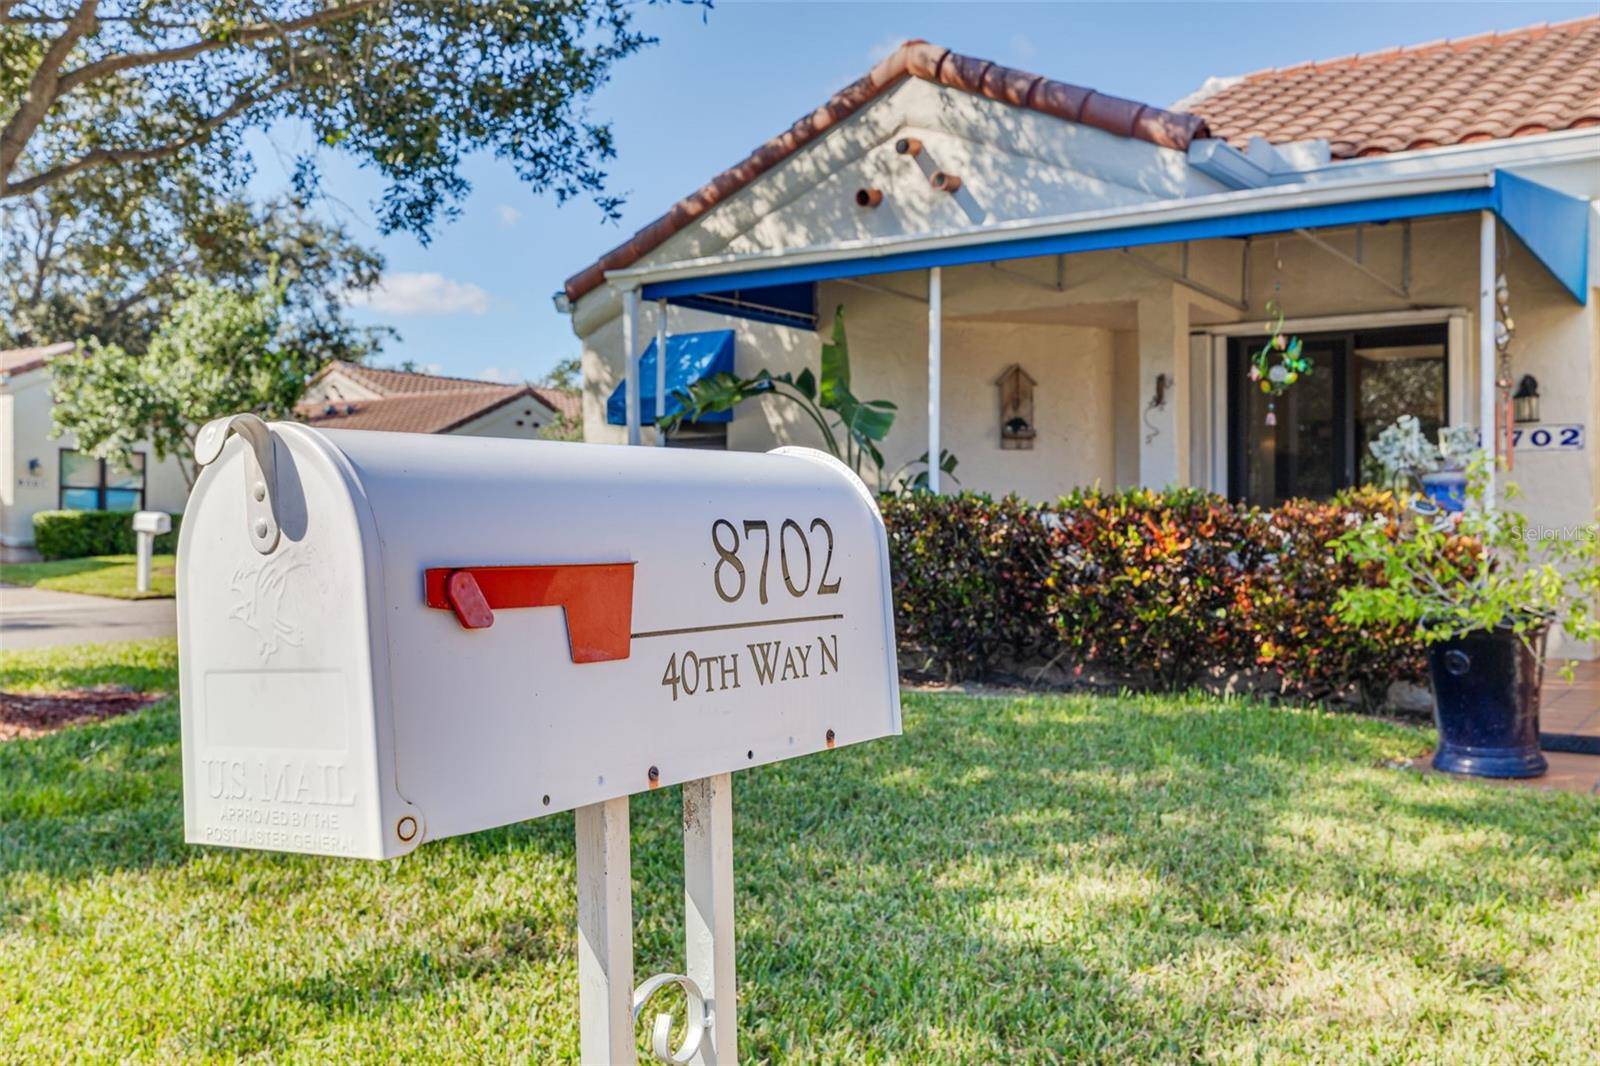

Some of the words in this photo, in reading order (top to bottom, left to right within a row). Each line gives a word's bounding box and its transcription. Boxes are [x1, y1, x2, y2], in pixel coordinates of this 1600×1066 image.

[1477, 428, 1580, 447] 702
[711, 518, 842, 605] 8702
[661, 650, 741, 701] 40TH
[747, 641, 812, 686] WAY
[817, 635, 839, 676] N
[202, 760, 253, 801] U.S.
[259, 762, 357, 807] MAIL
[220, 807, 289, 827] APPROVED
[292, 811, 310, 829] BY
[313, 812, 340, 831] THE
